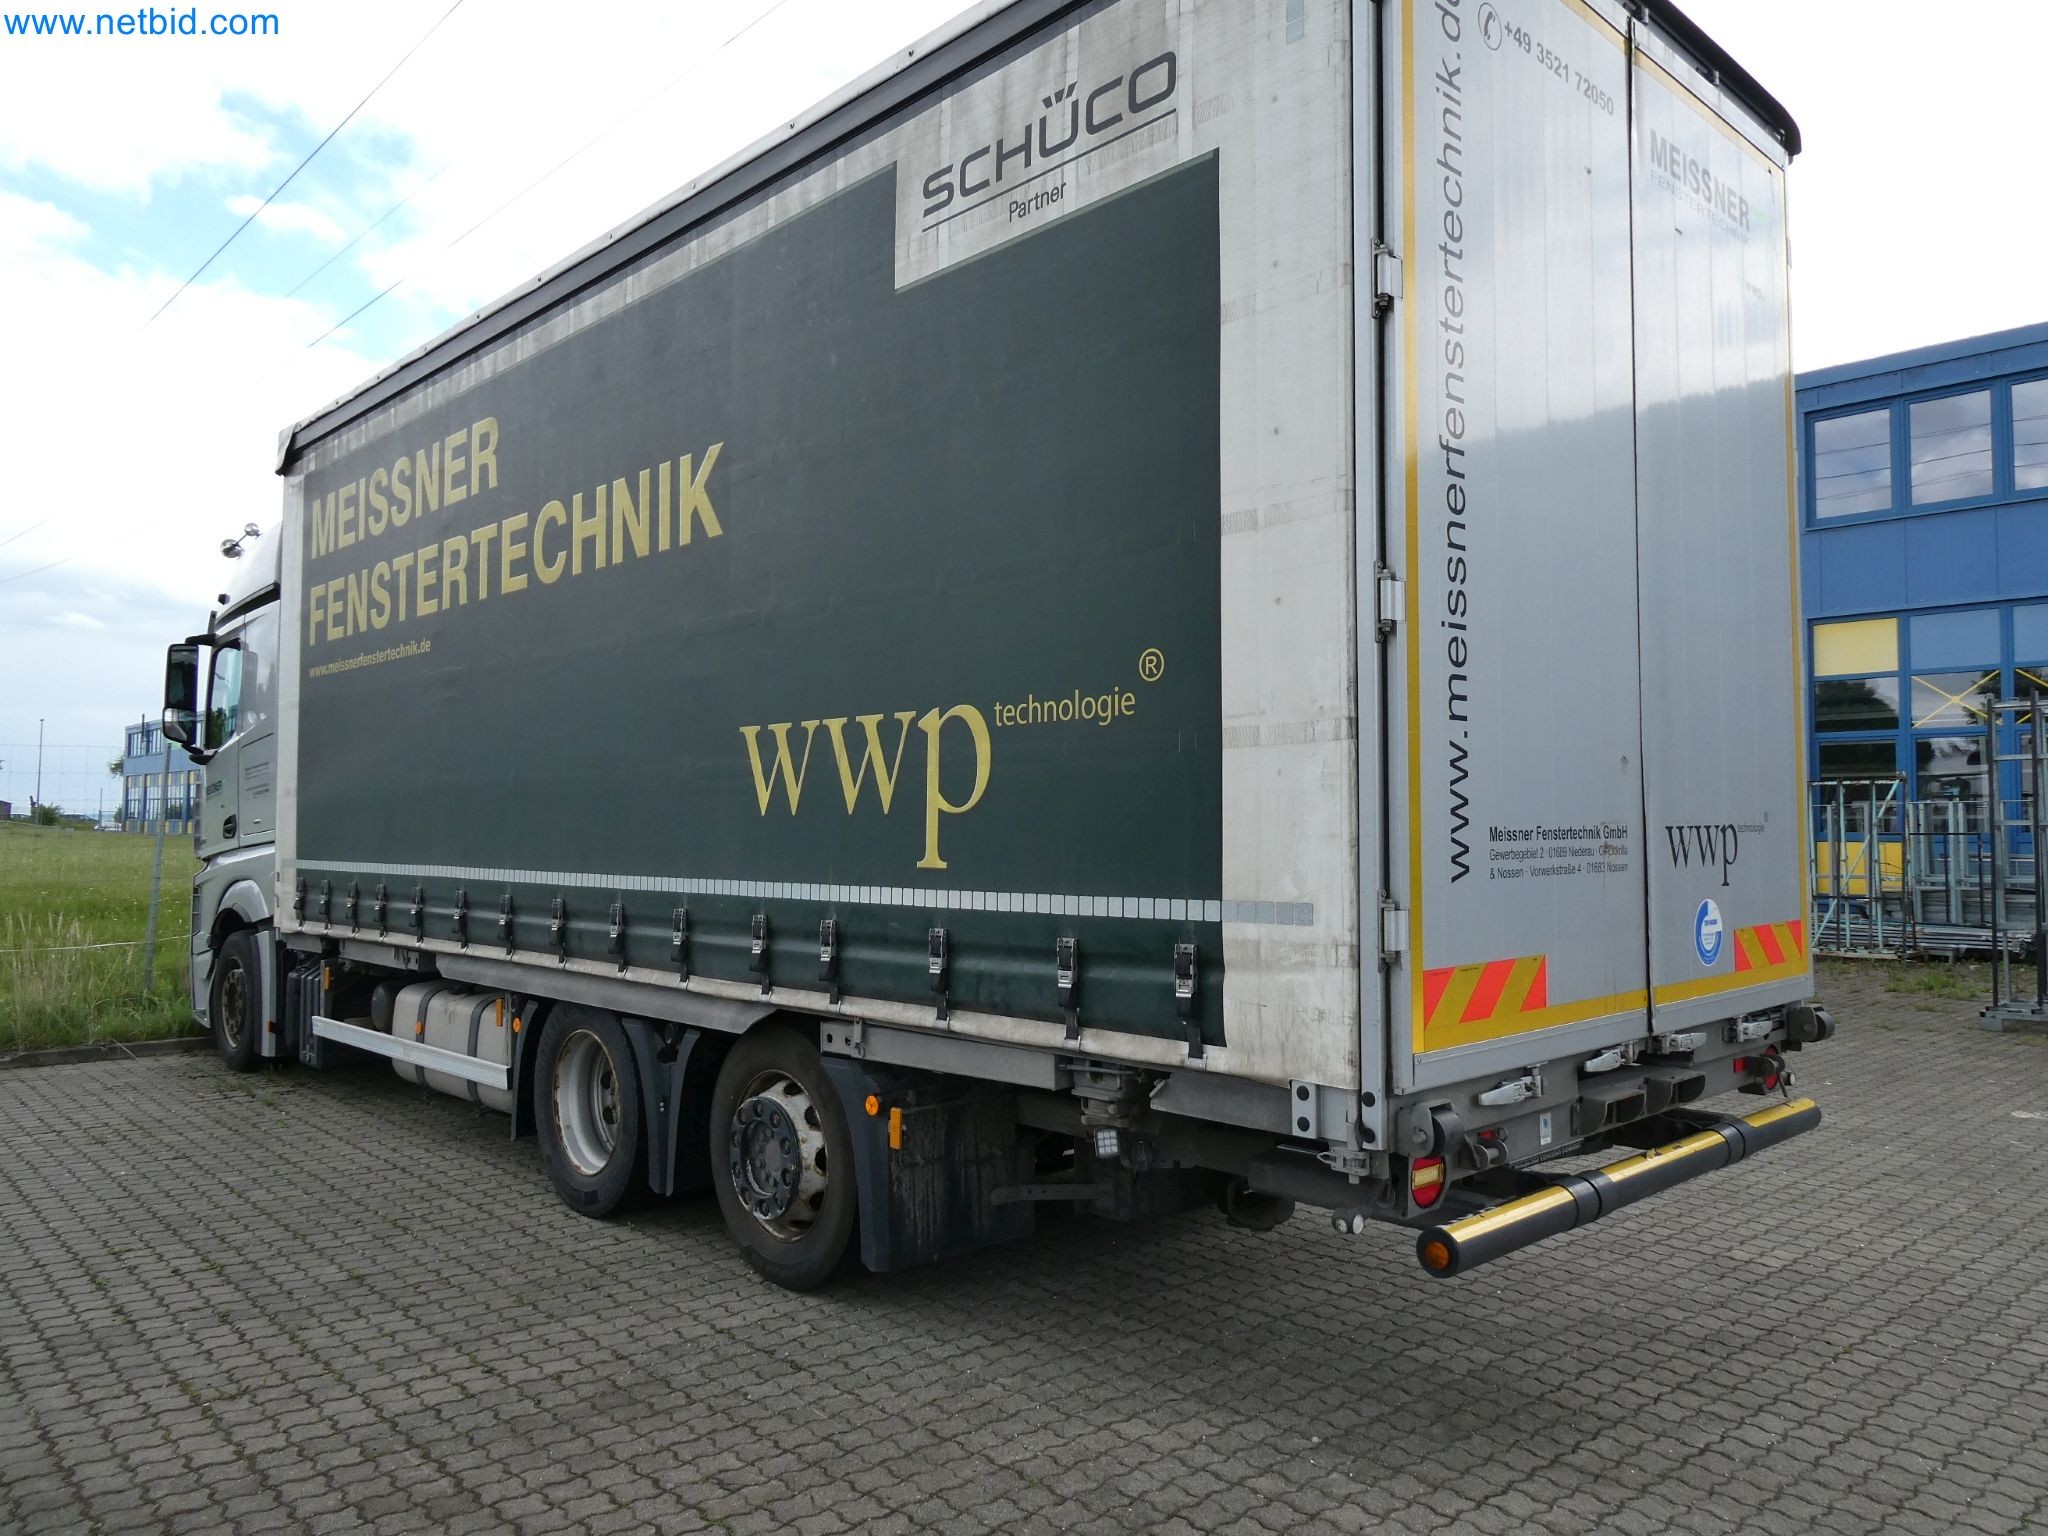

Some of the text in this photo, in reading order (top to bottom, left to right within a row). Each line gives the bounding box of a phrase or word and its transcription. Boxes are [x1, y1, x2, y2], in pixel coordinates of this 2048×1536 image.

[1504, 20, 1614, 116] +49 3521 72050
[922, 51, 1177, 218] SCHÜCO
[1008, 181, 1067, 223] Partner
[1650, 127, 1750, 232] MEISSNER
[310, 416, 499, 559] MEISSNER
[309, 441, 724, 646] FENSTERTECHNIK
[309, 638, 431, 678] www.meissnerfenstertechnik.de
[739, 704, 992, 869] wwp
[993, 686, 1136, 726] technologie
[1489, 825, 1628, 842] Meissner Fenstertechnik GmbH
[1489, 847, 1539, 862] Gewerbegebiet
[1548, 846, 1568, 858] 01689
[1489, 867, 1496, 879] &
[1497, 866, 1524, 879] Nossen
[1529, 863, 1576, 877] Vorwerkstraße
[1577, 862, 1582, 872] 4
[1606, 861, 1629, 873] Nossen
[1665, 823, 1738, 886] wwp
